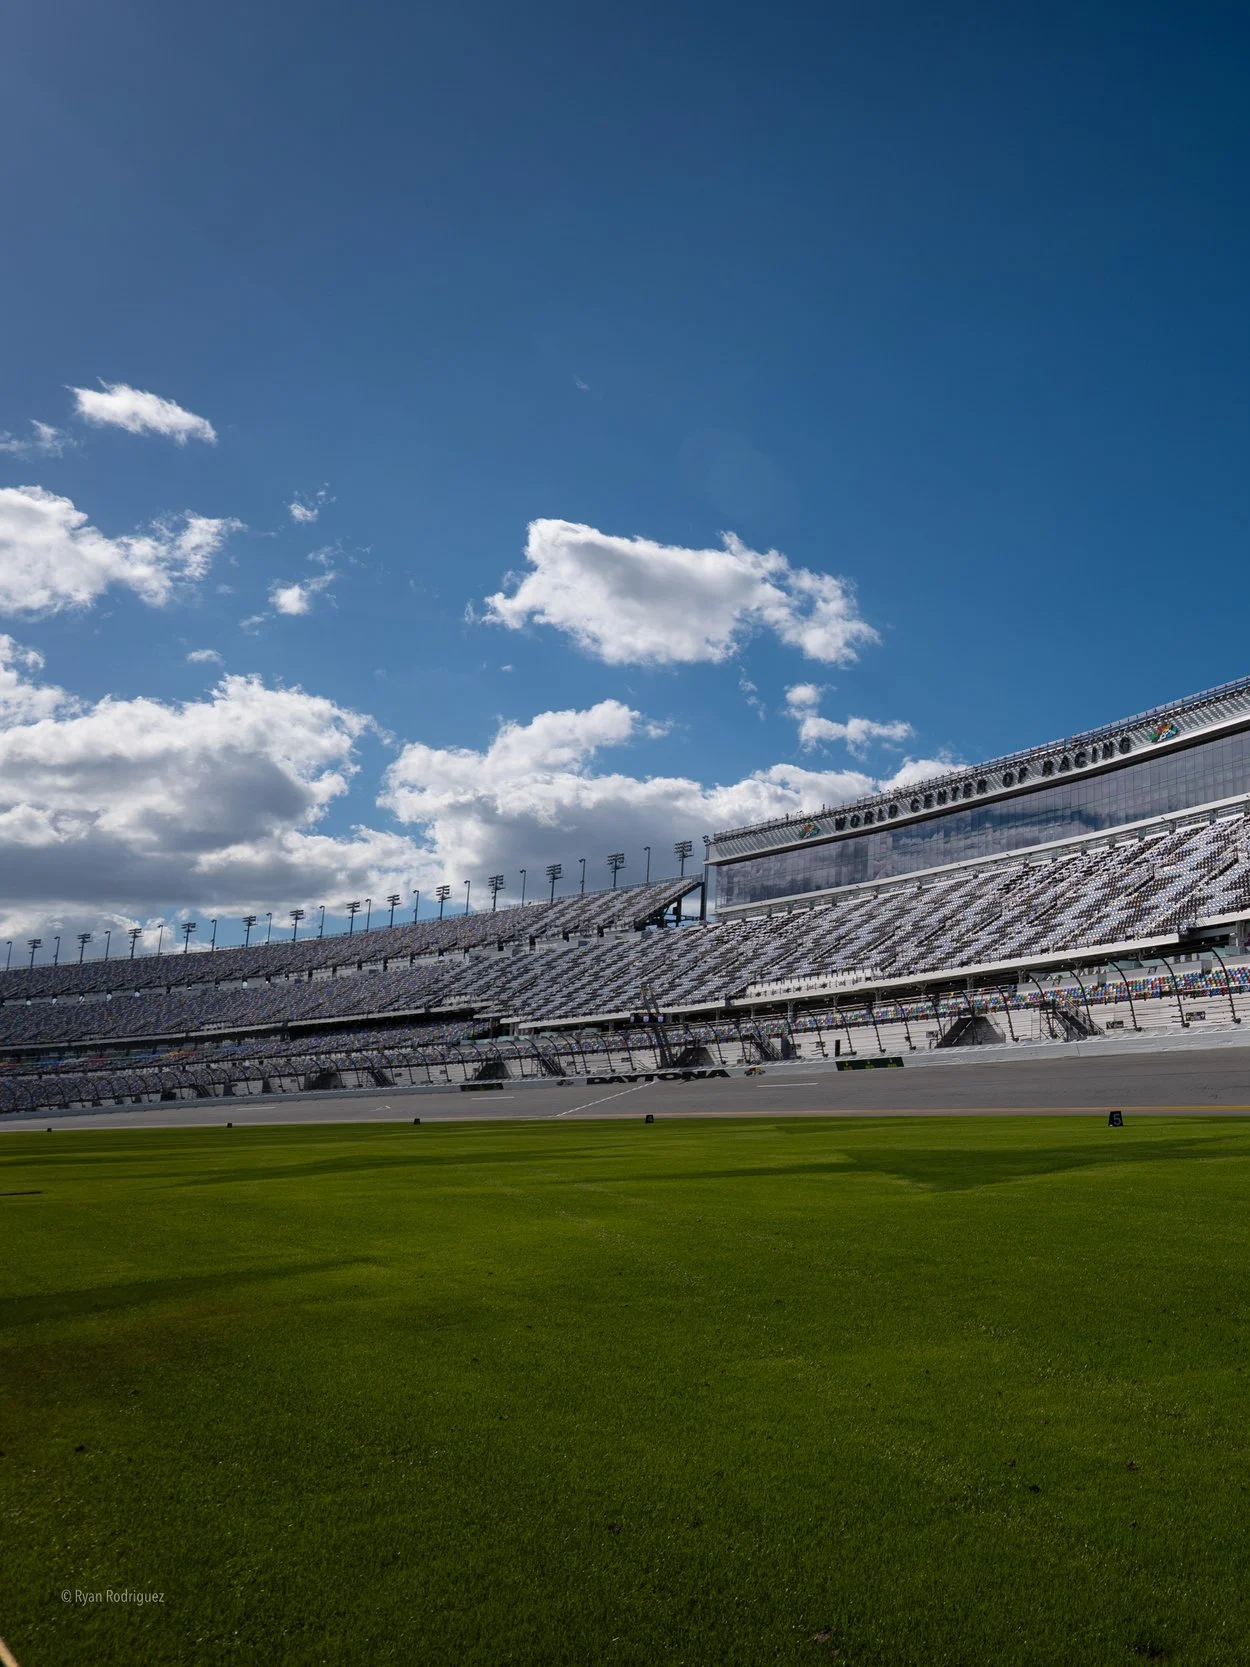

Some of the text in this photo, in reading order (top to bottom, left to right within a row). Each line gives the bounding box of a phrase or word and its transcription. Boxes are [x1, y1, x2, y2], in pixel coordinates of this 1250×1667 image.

[835, 737, 1131, 831] WORLD CENTER OF RACING
[587, 1069, 731, 1085] DAYTONA
[1113, 1113, 1121, 1125] 5
